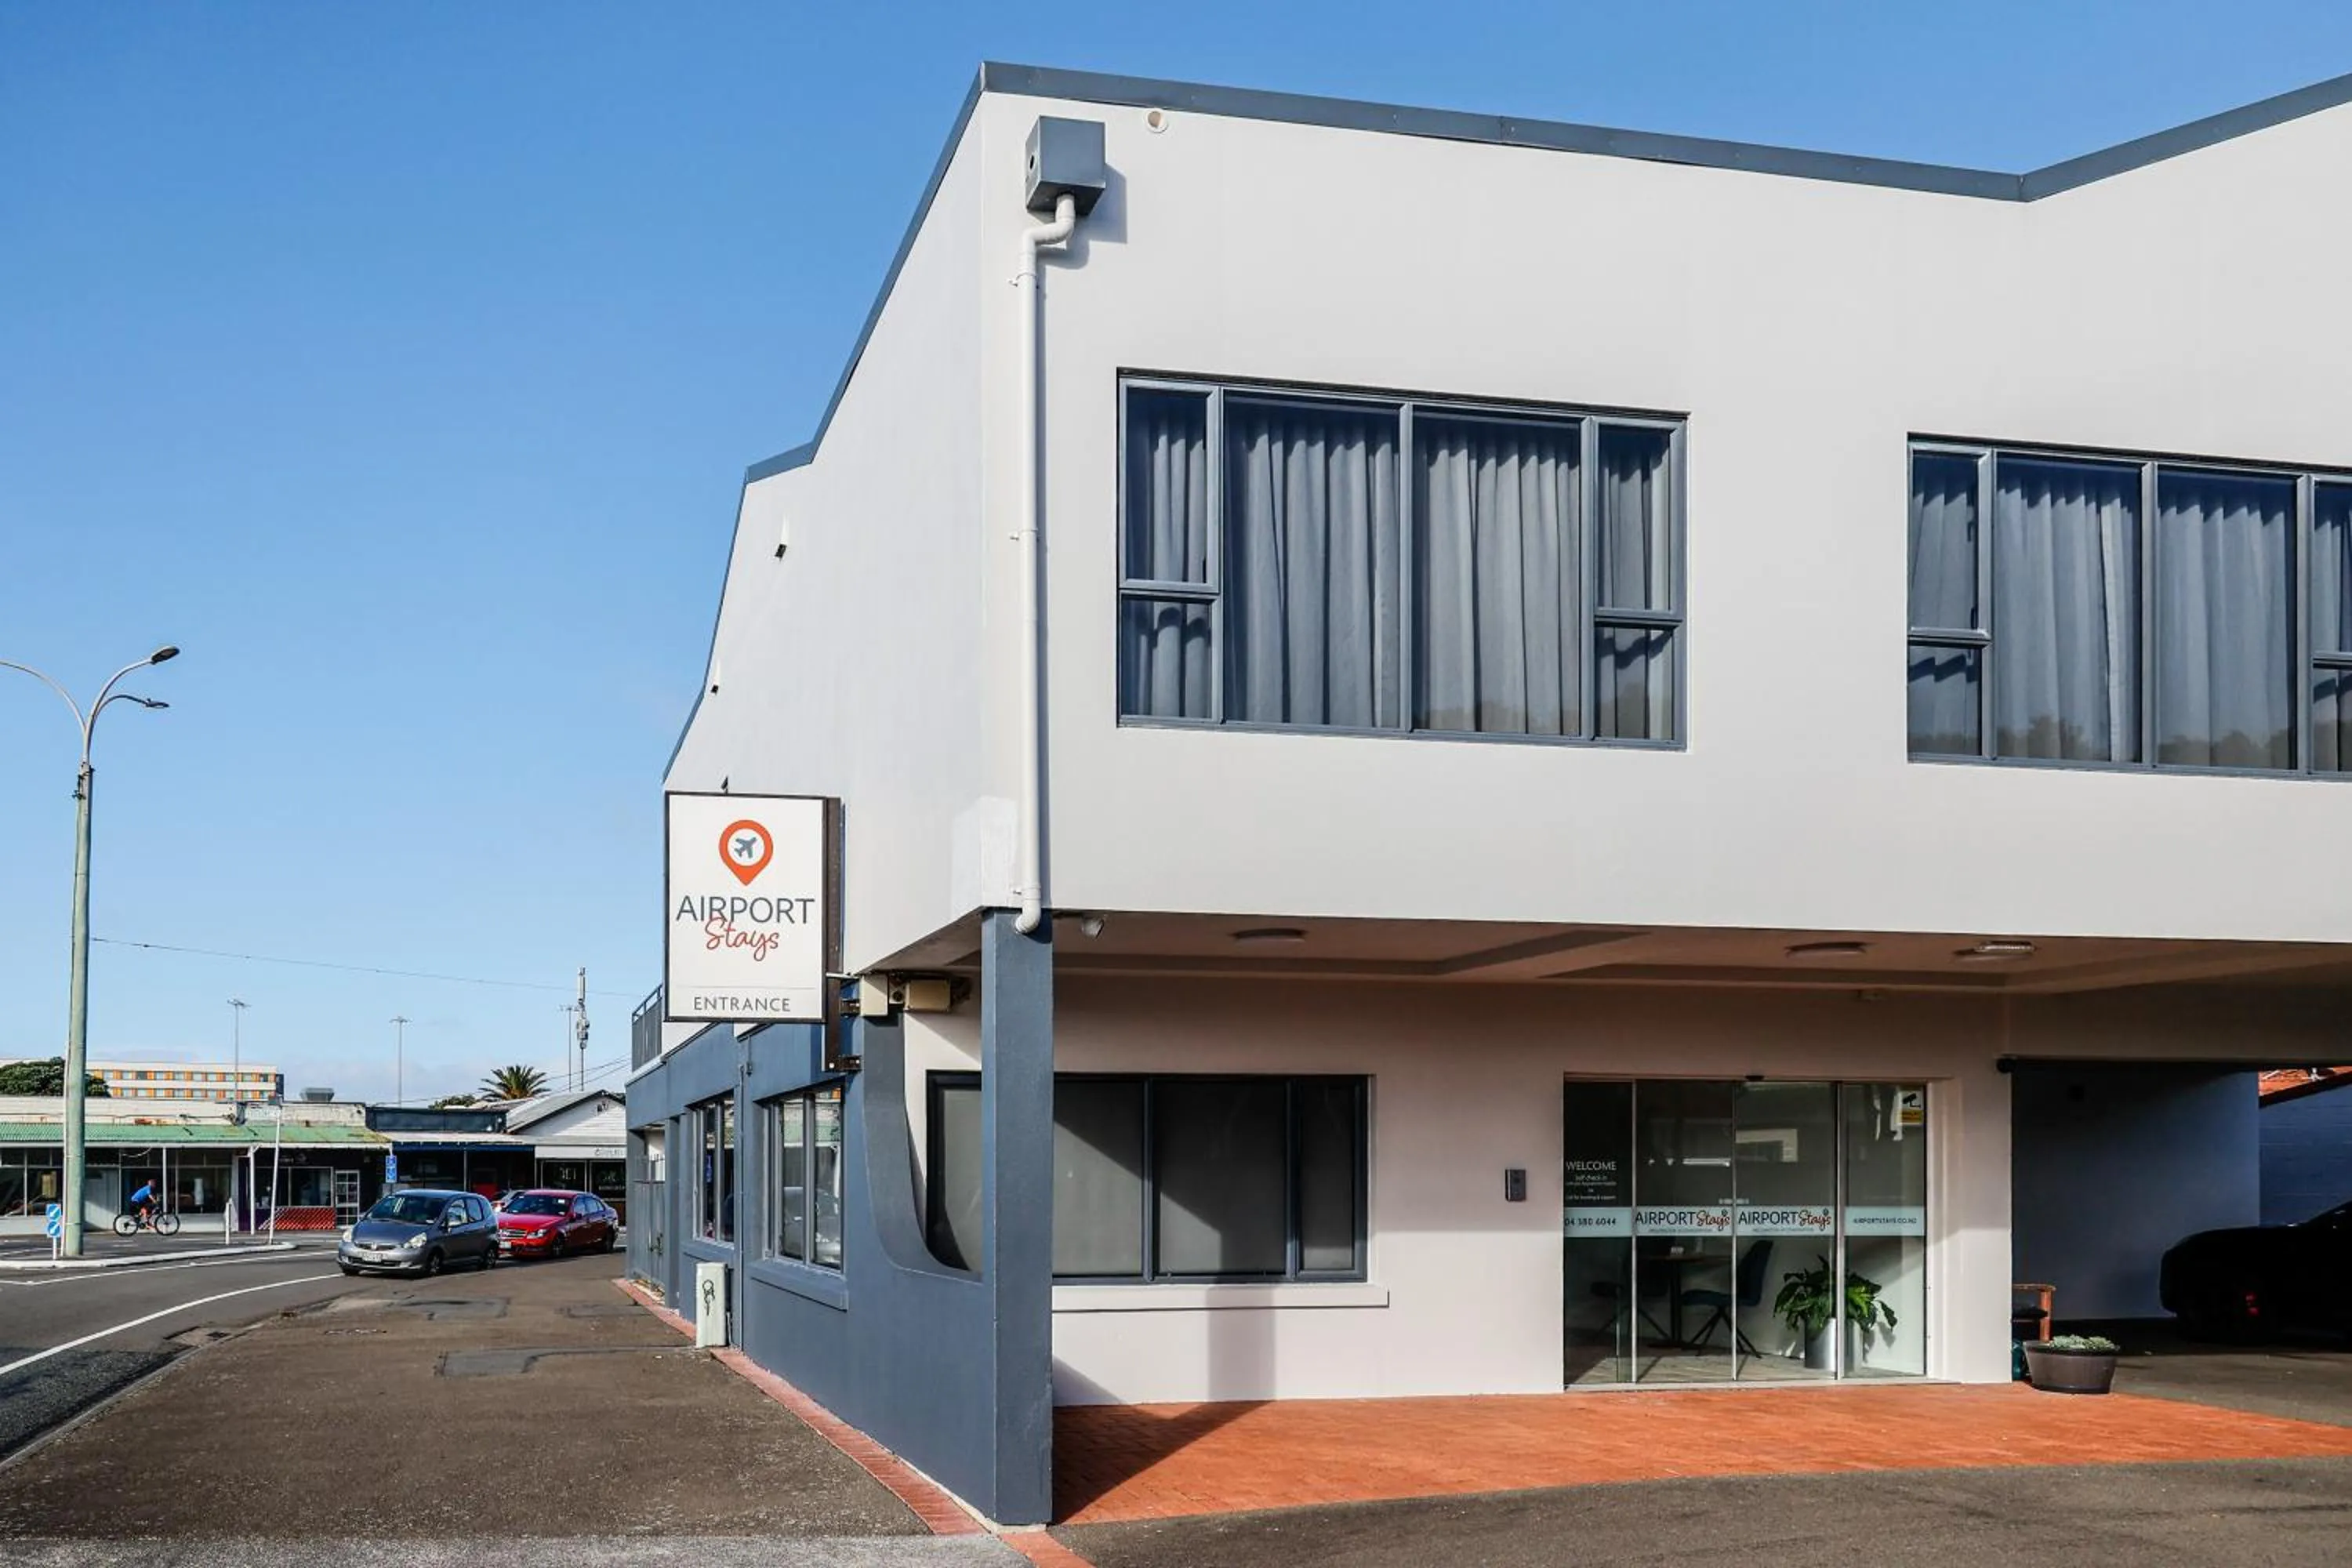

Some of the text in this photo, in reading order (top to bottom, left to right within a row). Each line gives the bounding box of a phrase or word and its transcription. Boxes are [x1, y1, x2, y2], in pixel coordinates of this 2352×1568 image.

[676, 895, 815, 924] AIRPORT
[704, 916, 780, 962] Stays
[693, 996, 791, 1012] ENTRANCE
[1566, 1160, 1617, 1171] WELCOME
[1635, 1210, 1730, 1232] AIRPORT Stays
[1738, 1210, 1832, 1232] AIRPORT Stays
